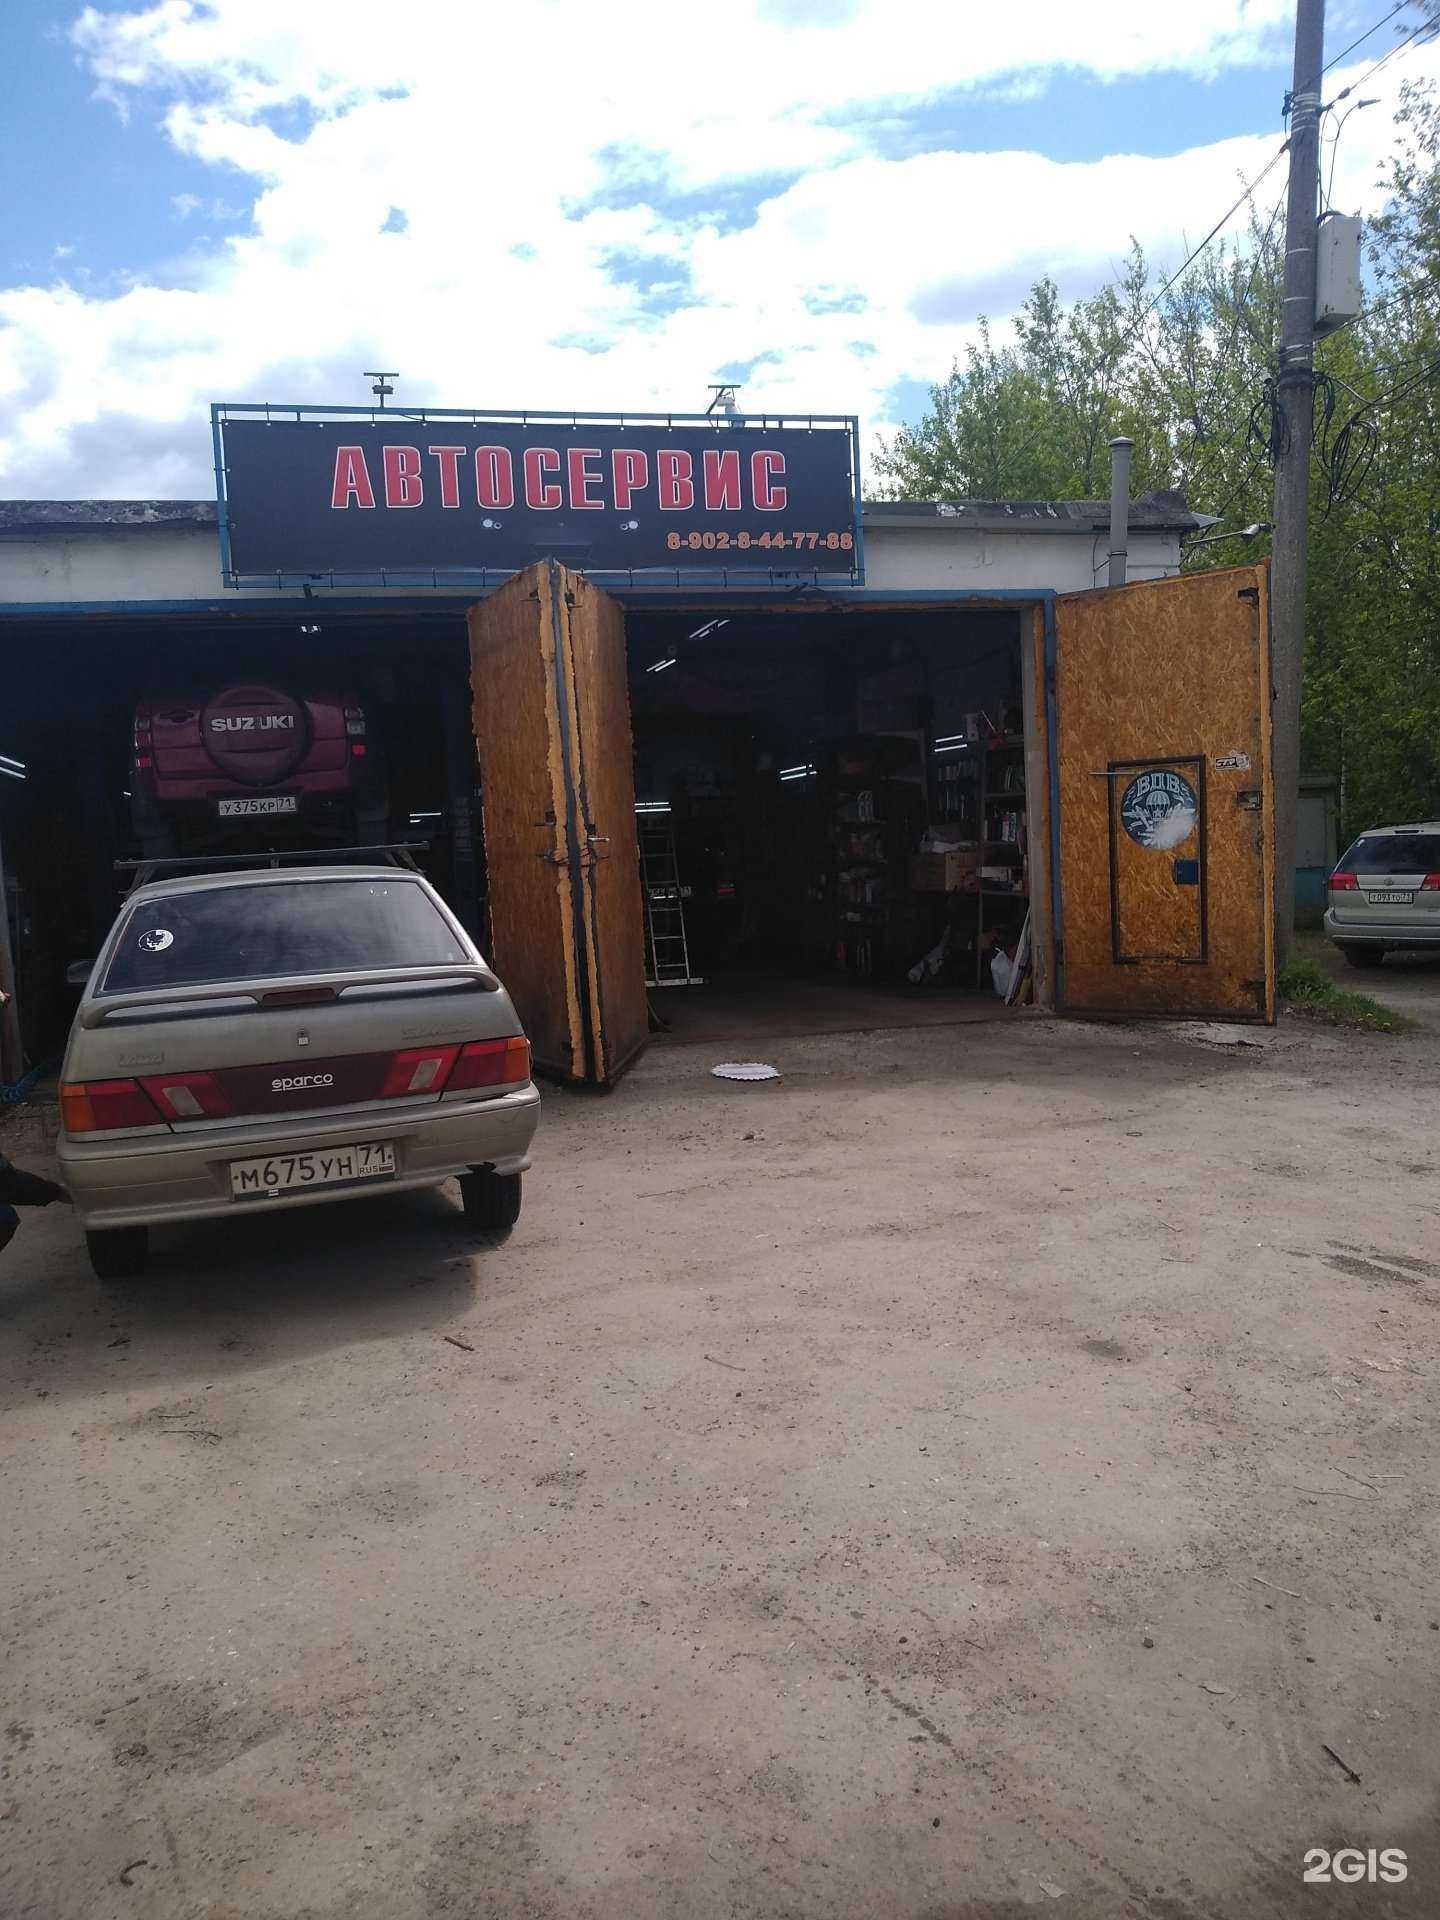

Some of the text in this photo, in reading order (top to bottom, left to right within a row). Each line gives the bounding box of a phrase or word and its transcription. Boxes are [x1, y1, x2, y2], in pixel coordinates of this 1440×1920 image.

[331, 446, 787, 511] АВТОСЕРВИС
[211, 715, 294, 732] SUZUKI
[271, 1073, 333, 1092] sparco
[239, 1155, 353, 1190] М675УН
